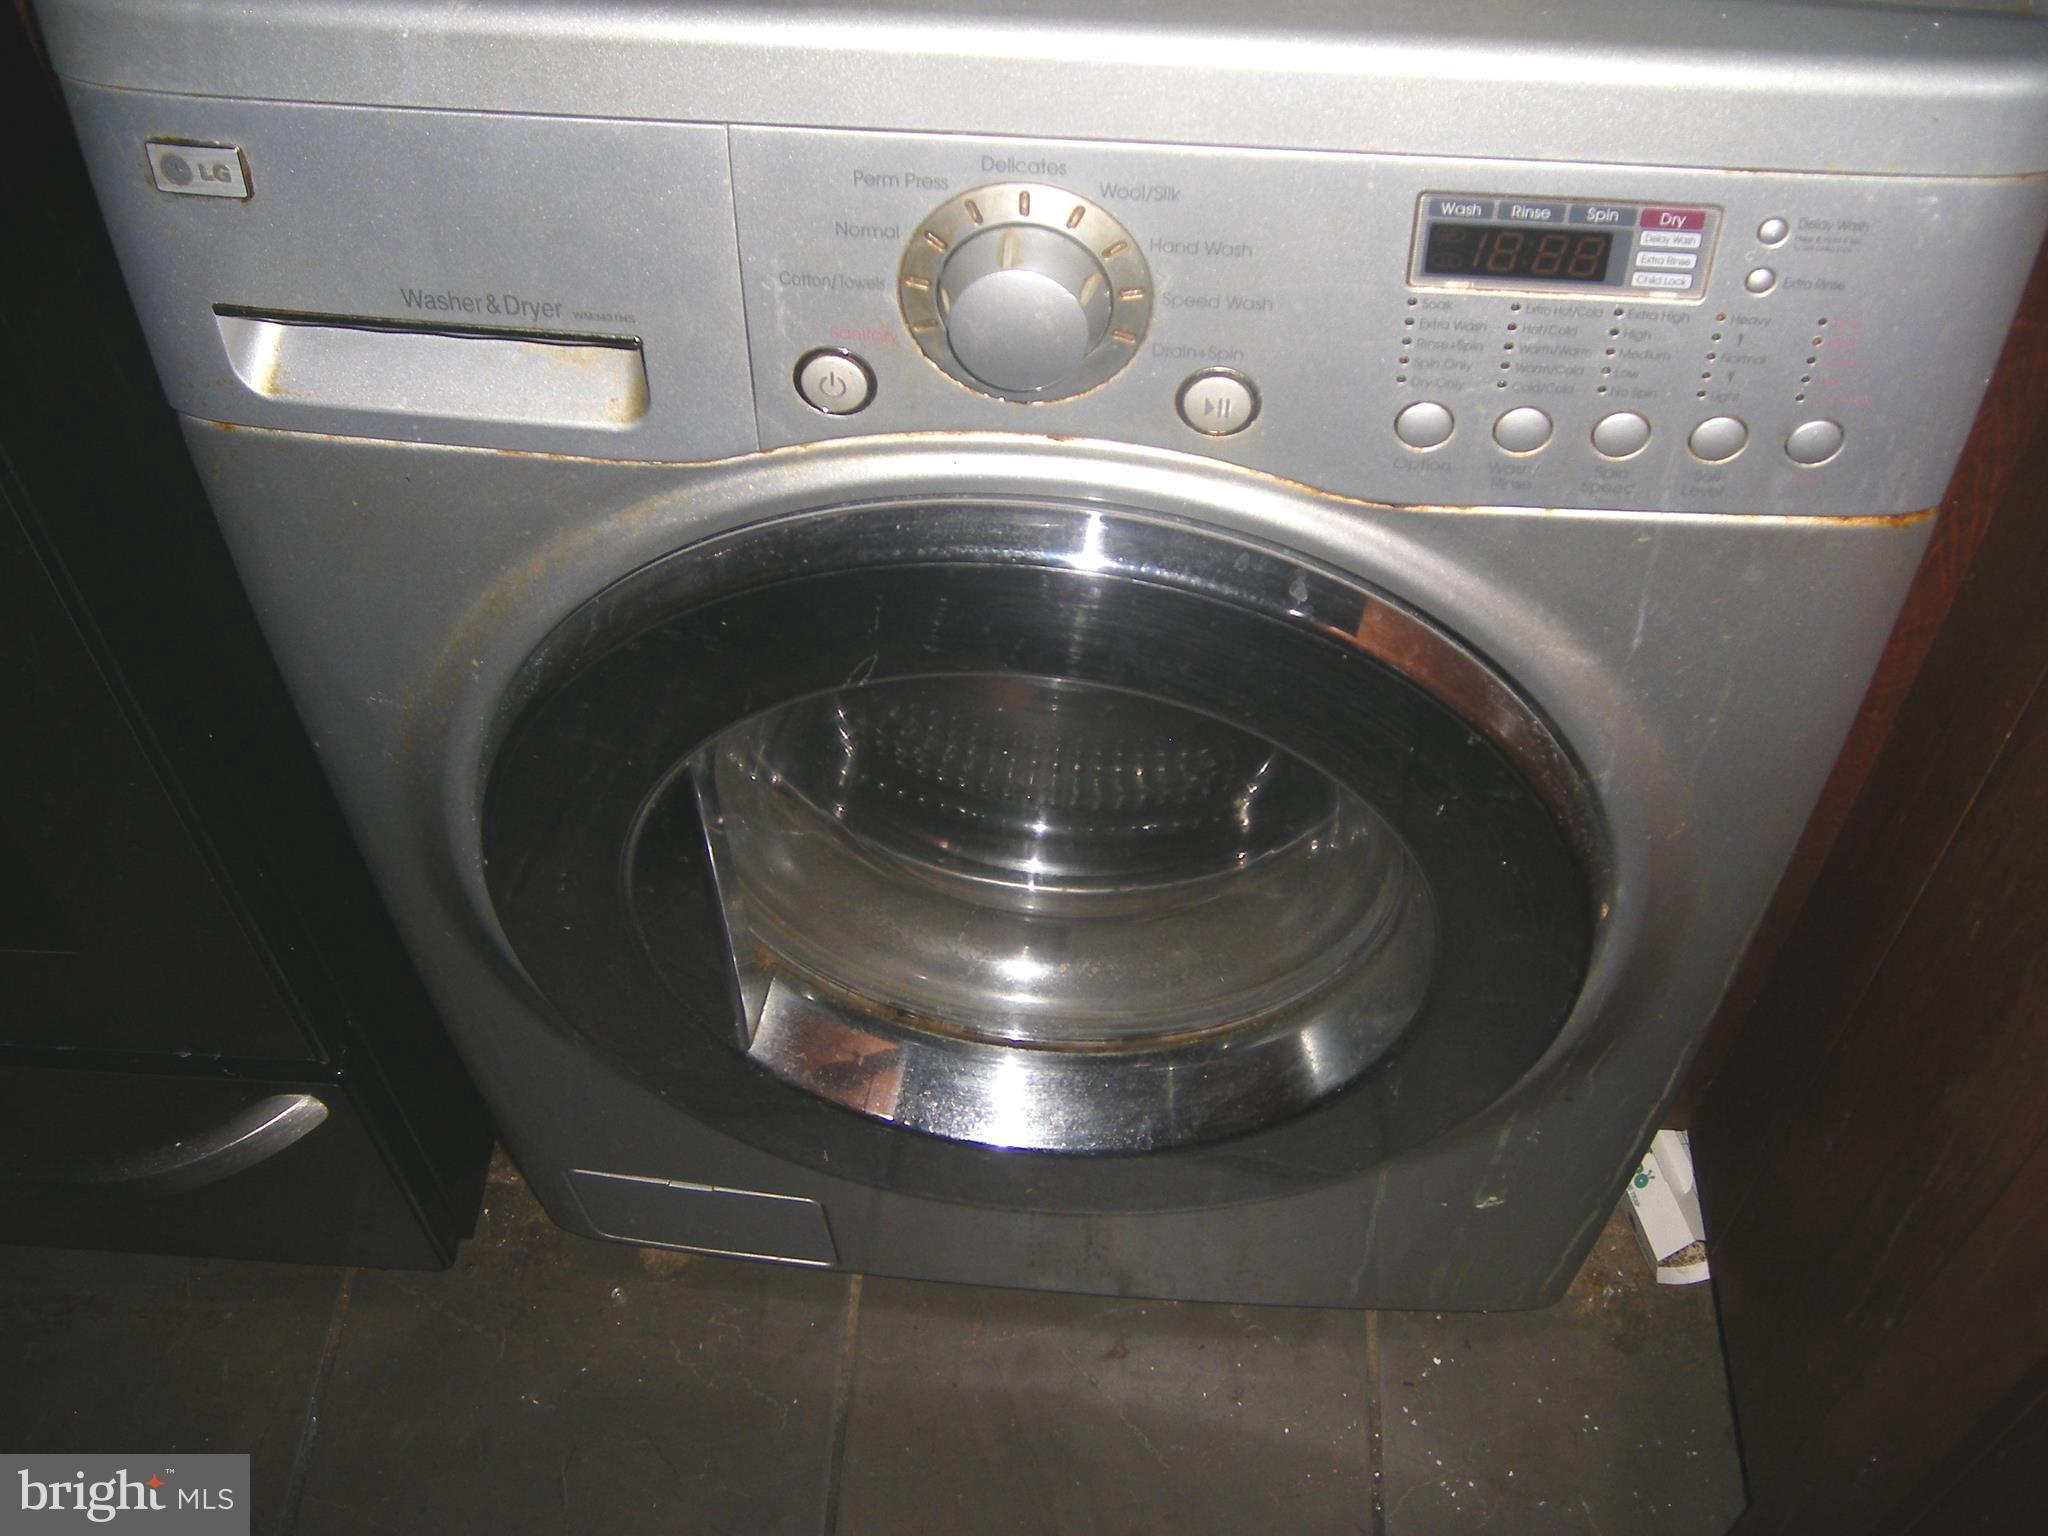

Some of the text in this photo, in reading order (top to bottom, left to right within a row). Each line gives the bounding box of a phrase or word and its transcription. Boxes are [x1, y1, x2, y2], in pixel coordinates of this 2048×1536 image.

[198, 163, 232, 184] LG
[981, 155, 1067, 177] Delicates
[853, 169, 949, 190] Perm Press
[1100, 183, 1181, 201] Wool/Silk
[1441, 201, 1482, 217] Wash
[1511, 205, 1551, 220] Rinse
[1587, 207, 1619, 224] Spin
[1660, 212, 1687, 229] Dry
[835, 221, 900, 239] Normal
[1150, 237, 1253, 257] Hand Wash
[779, 271, 886, 290] Cotton/Towels
[1636, 274, 1687, 286] Child Lock
[400, 288, 483, 313] Washer
[504, 294, 563, 321] Dryer
[1162, 292, 1274, 312] Speed Wash
[1627, 309, 1690, 324] Extra High
[1152, 342, 1245, 362] Drain+Spin
